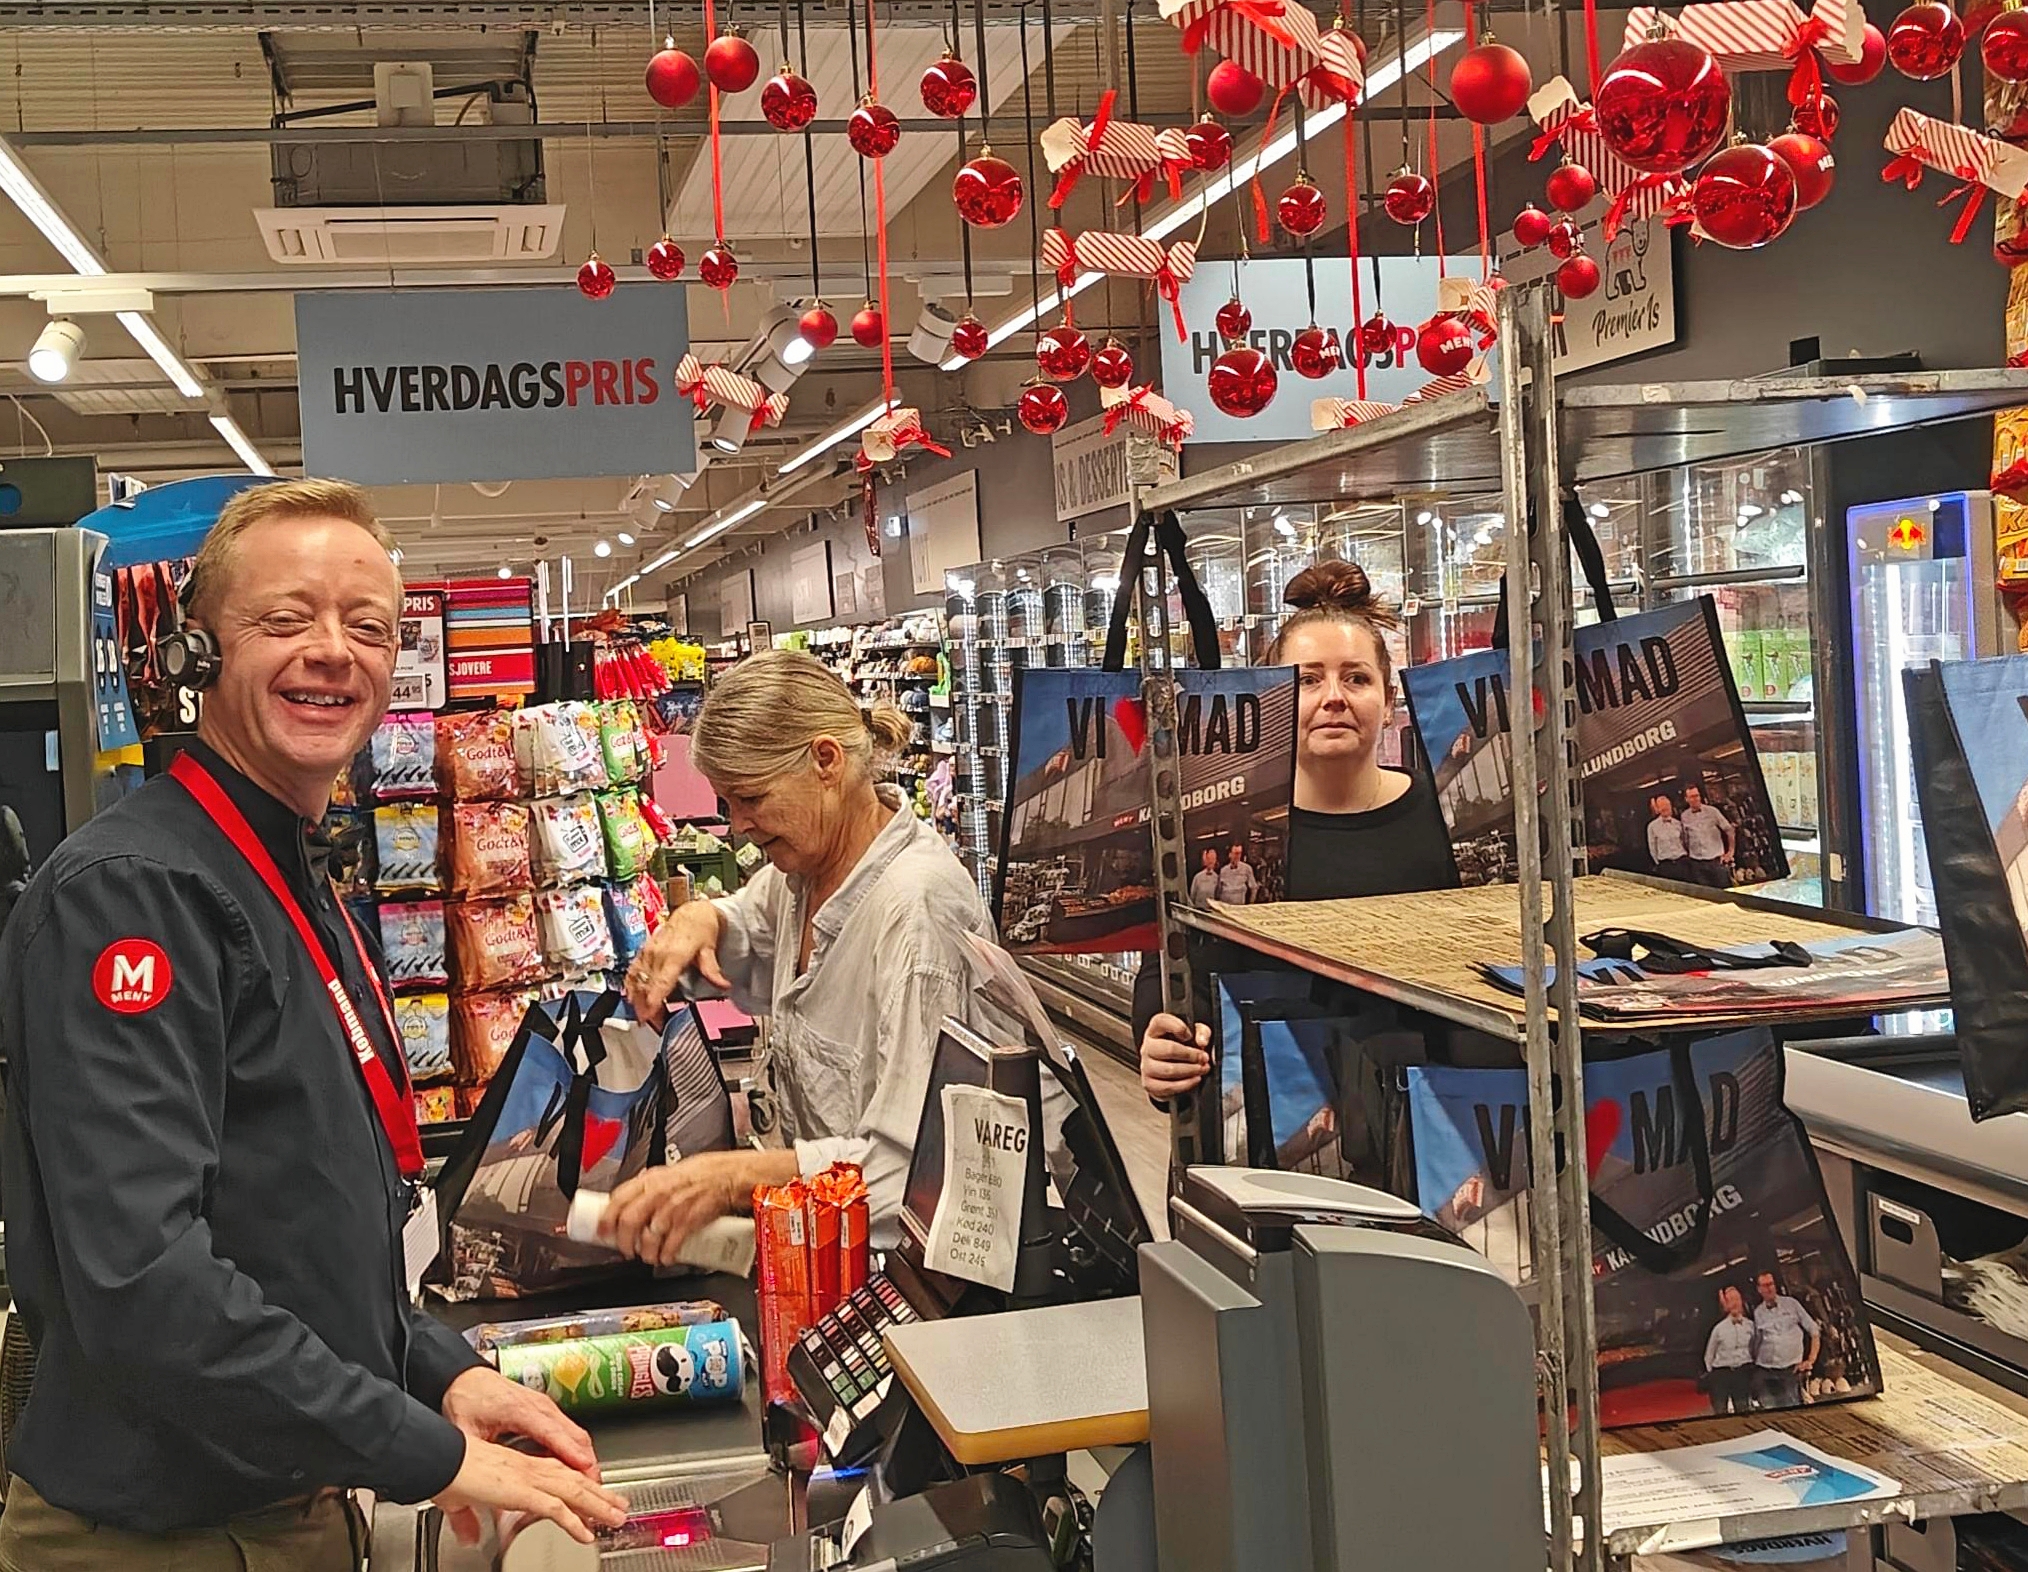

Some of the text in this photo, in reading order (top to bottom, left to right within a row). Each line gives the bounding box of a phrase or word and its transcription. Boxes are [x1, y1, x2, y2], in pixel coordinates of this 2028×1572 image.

[1591, 299, 1643, 348] Premier
[333, 357, 660, 414] HVERDAGSPRIS
[403, 596, 435, 612] PRIS
[1455, 635, 1680, 738] VI MAD
[1067, 692, 1261, 760] VI MAD
[1580, 719, 1678, 779] LUNDBORG
[111, 955, 155, 992] M
[111, 990, 153, 1004] MENY
[974, 1117, 1026, 1153] VAREG
[973, 1237, 991, 1252] 849
[976, 1221, 995, 1236] 240
[627, 1346, 655, 1399] PRINGLES
